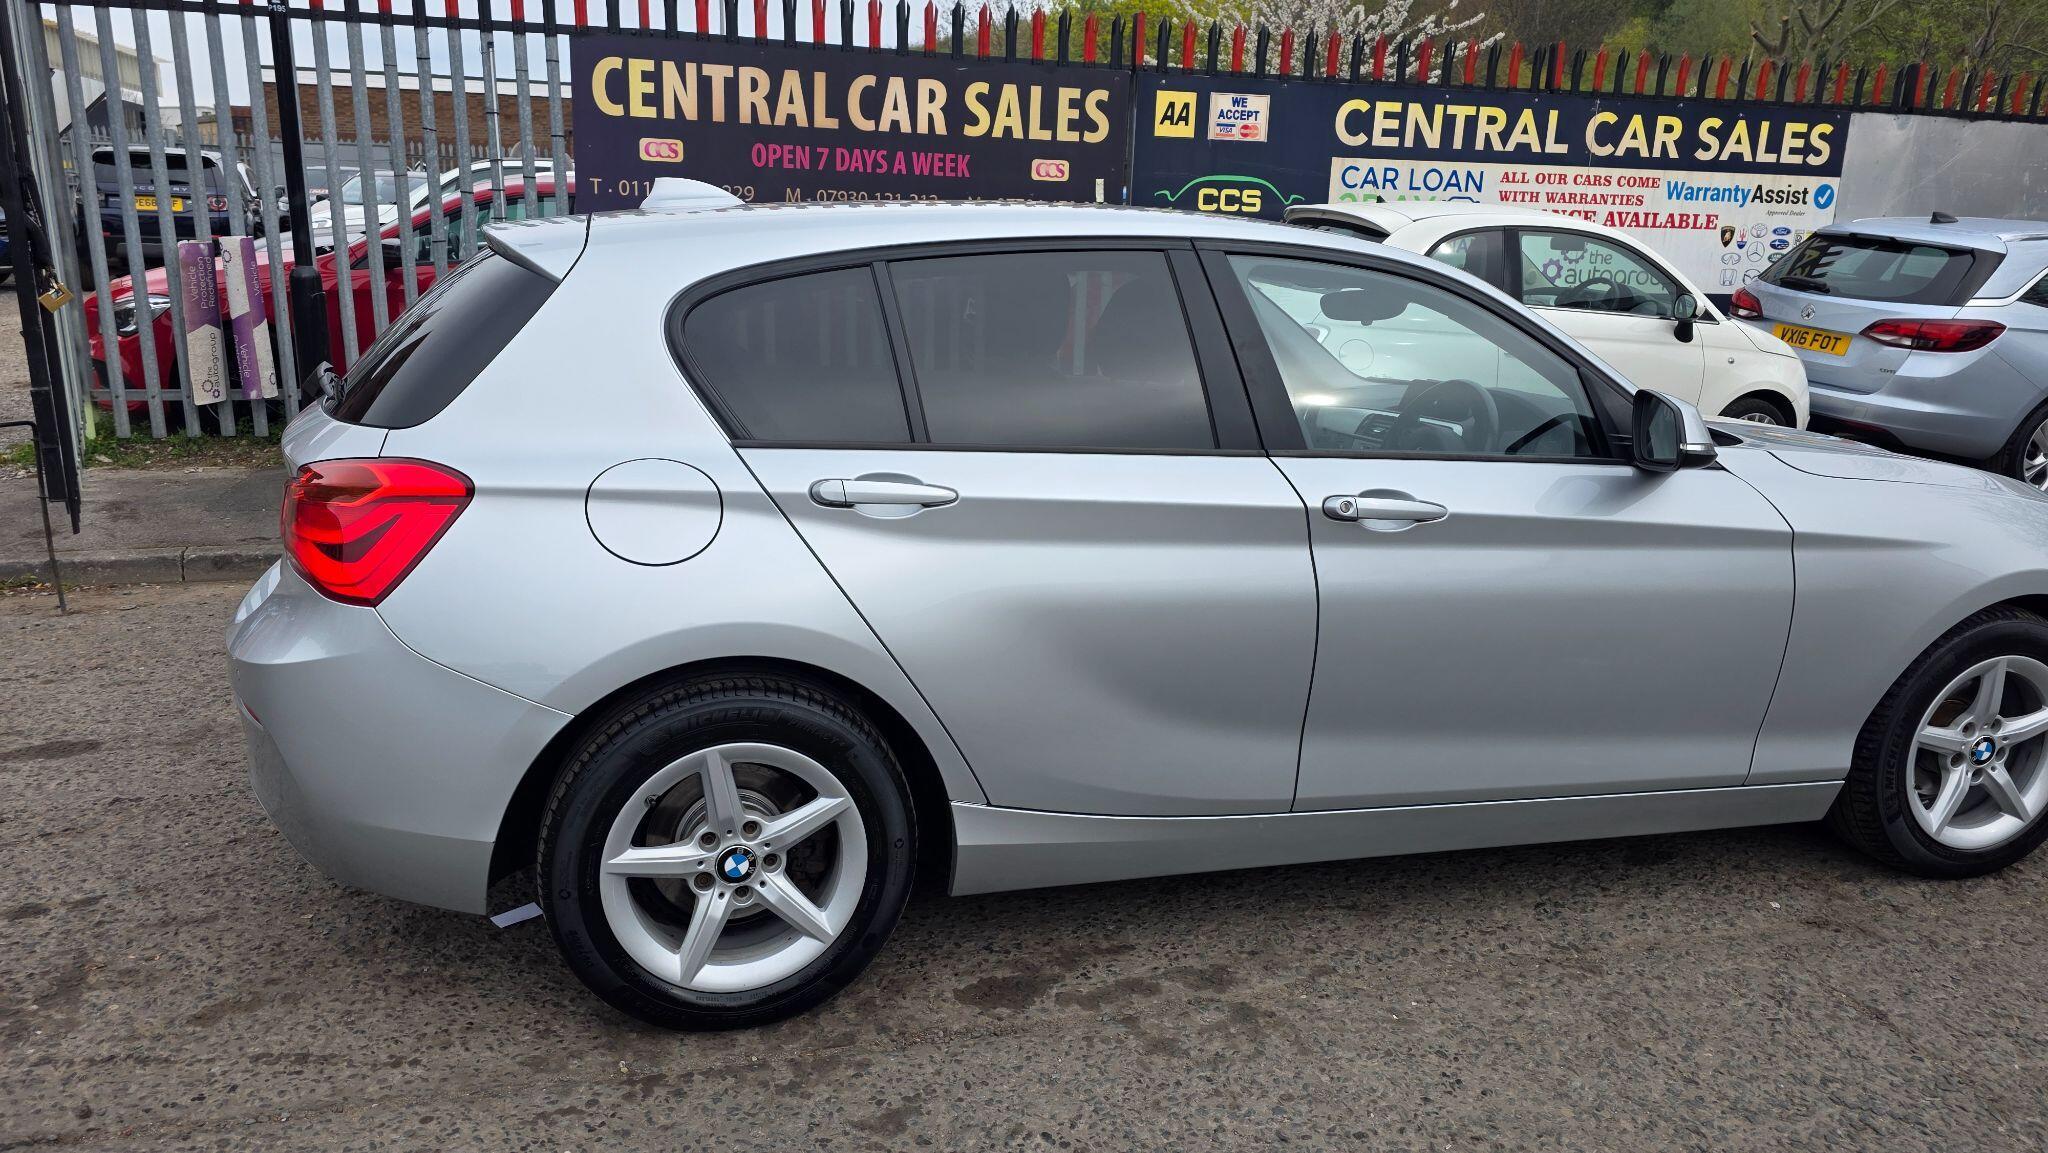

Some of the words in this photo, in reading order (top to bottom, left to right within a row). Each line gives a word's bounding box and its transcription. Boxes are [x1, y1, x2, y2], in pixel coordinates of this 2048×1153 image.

[591, 56, 839, 129] CENTRAL
[847, 74, 947, 136] CAR
[963, 81, 1110, 144] SALES
[1231, 96, 1248, 108] WE
[1159, 101, 1190, 127] AA
[1217, 108, 1260, 122] ACCEPT
[1335, 99, 1569, 154] CENTRAL
[1585, 111, 1683, 159] CAR
[1694, 117, 1835, 166] SALES
[644, 141, 679, 159] CCS
[751, 142, 810, 170] OPEN
[816, 147, 829, 171] 7
[836, 147, 888, 175] DAYS
[893, 151, 907, 175] A
[912, 151, 971, 178] WEEK
[1035, 162, 1066, 179] CCS
[1341, 165, 1399, 191] CAR
[1408, 168, 1484, 193] LOAN
[1500, 171, 1530, 184] ALL
[1535, 172, 1568, 185] OUR
[1573, 174, 1612, 187] CARS
[1616, 176, 1661, 189] COME
[1198, 187, 1262, 212] CCS
[1499, 190, 1540, 203] WITH
[1545, 191, 1644, 207] WARRANTIES
[1602, 210, 1719, 230] AVAILABLE
[1589, 250, 1613, 264] the
[187, 265, 200, 302] Vehicle
[197, 256, 209, 310] Protection
[204, 256, 216, 307] Redefined
[250, 261, 260, 296] Vehicle
[1781, 327, 1806, 345] VX16
[1809, 333, 1842, 351] FOT
[209, 332, 220, 388] autogroup
[239, 343, 252, 378] Vehicle
